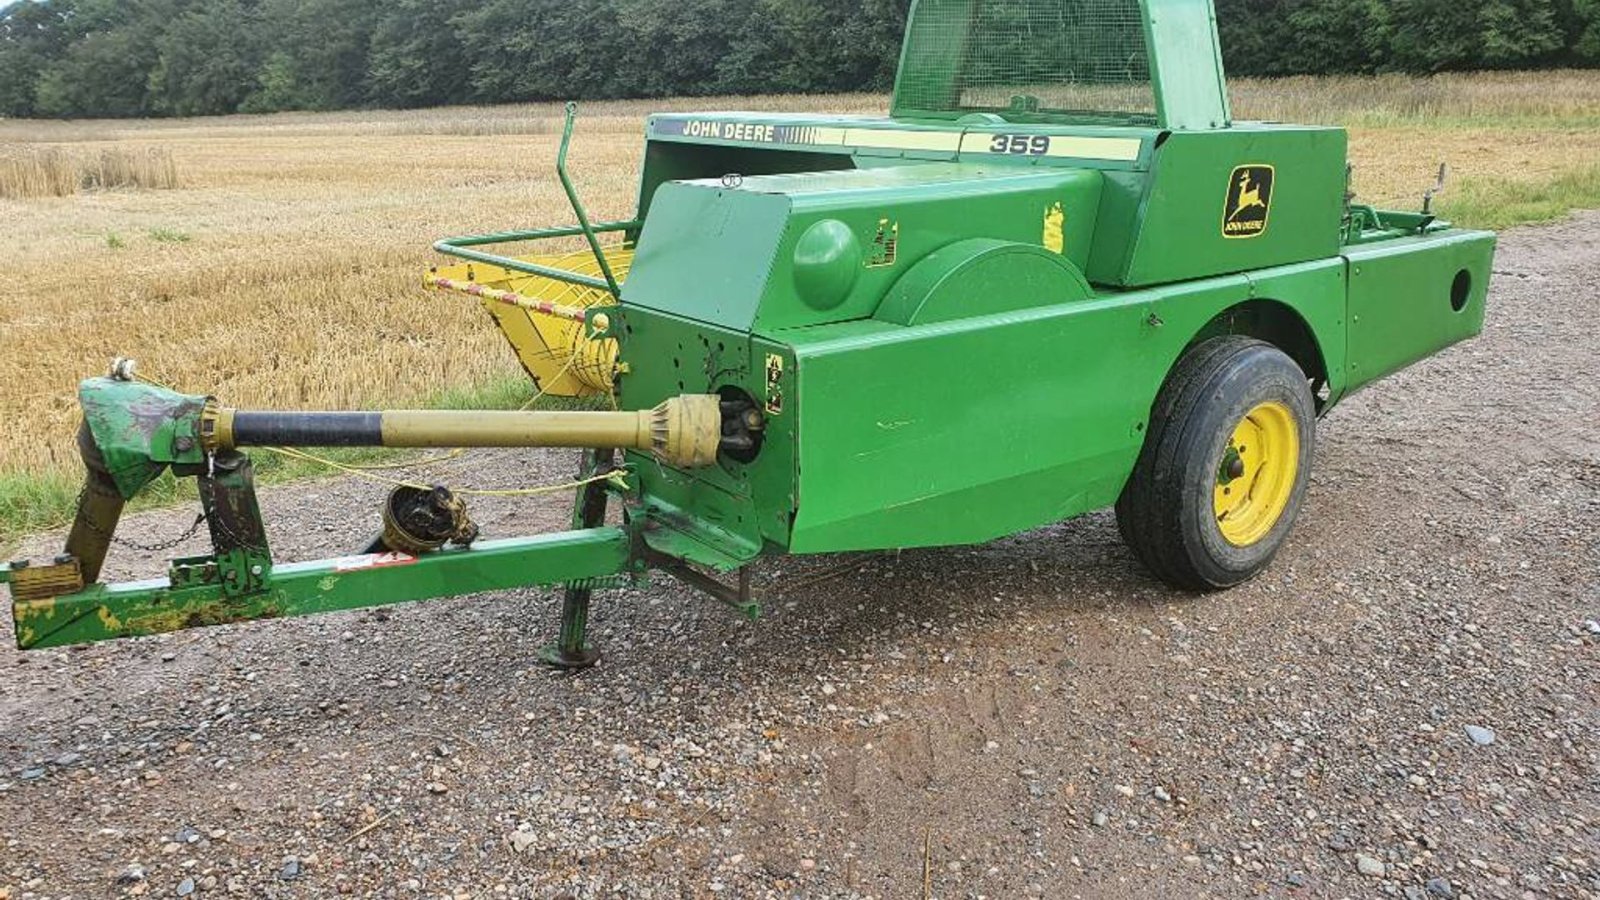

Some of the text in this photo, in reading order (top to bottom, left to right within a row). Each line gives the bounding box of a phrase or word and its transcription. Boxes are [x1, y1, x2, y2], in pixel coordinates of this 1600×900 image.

[683, 120, 775, 142] JOHN DEERE
[989, 134, 1050, 154] 359
[1225, 220, 1262, 231] JOHN DEERE
